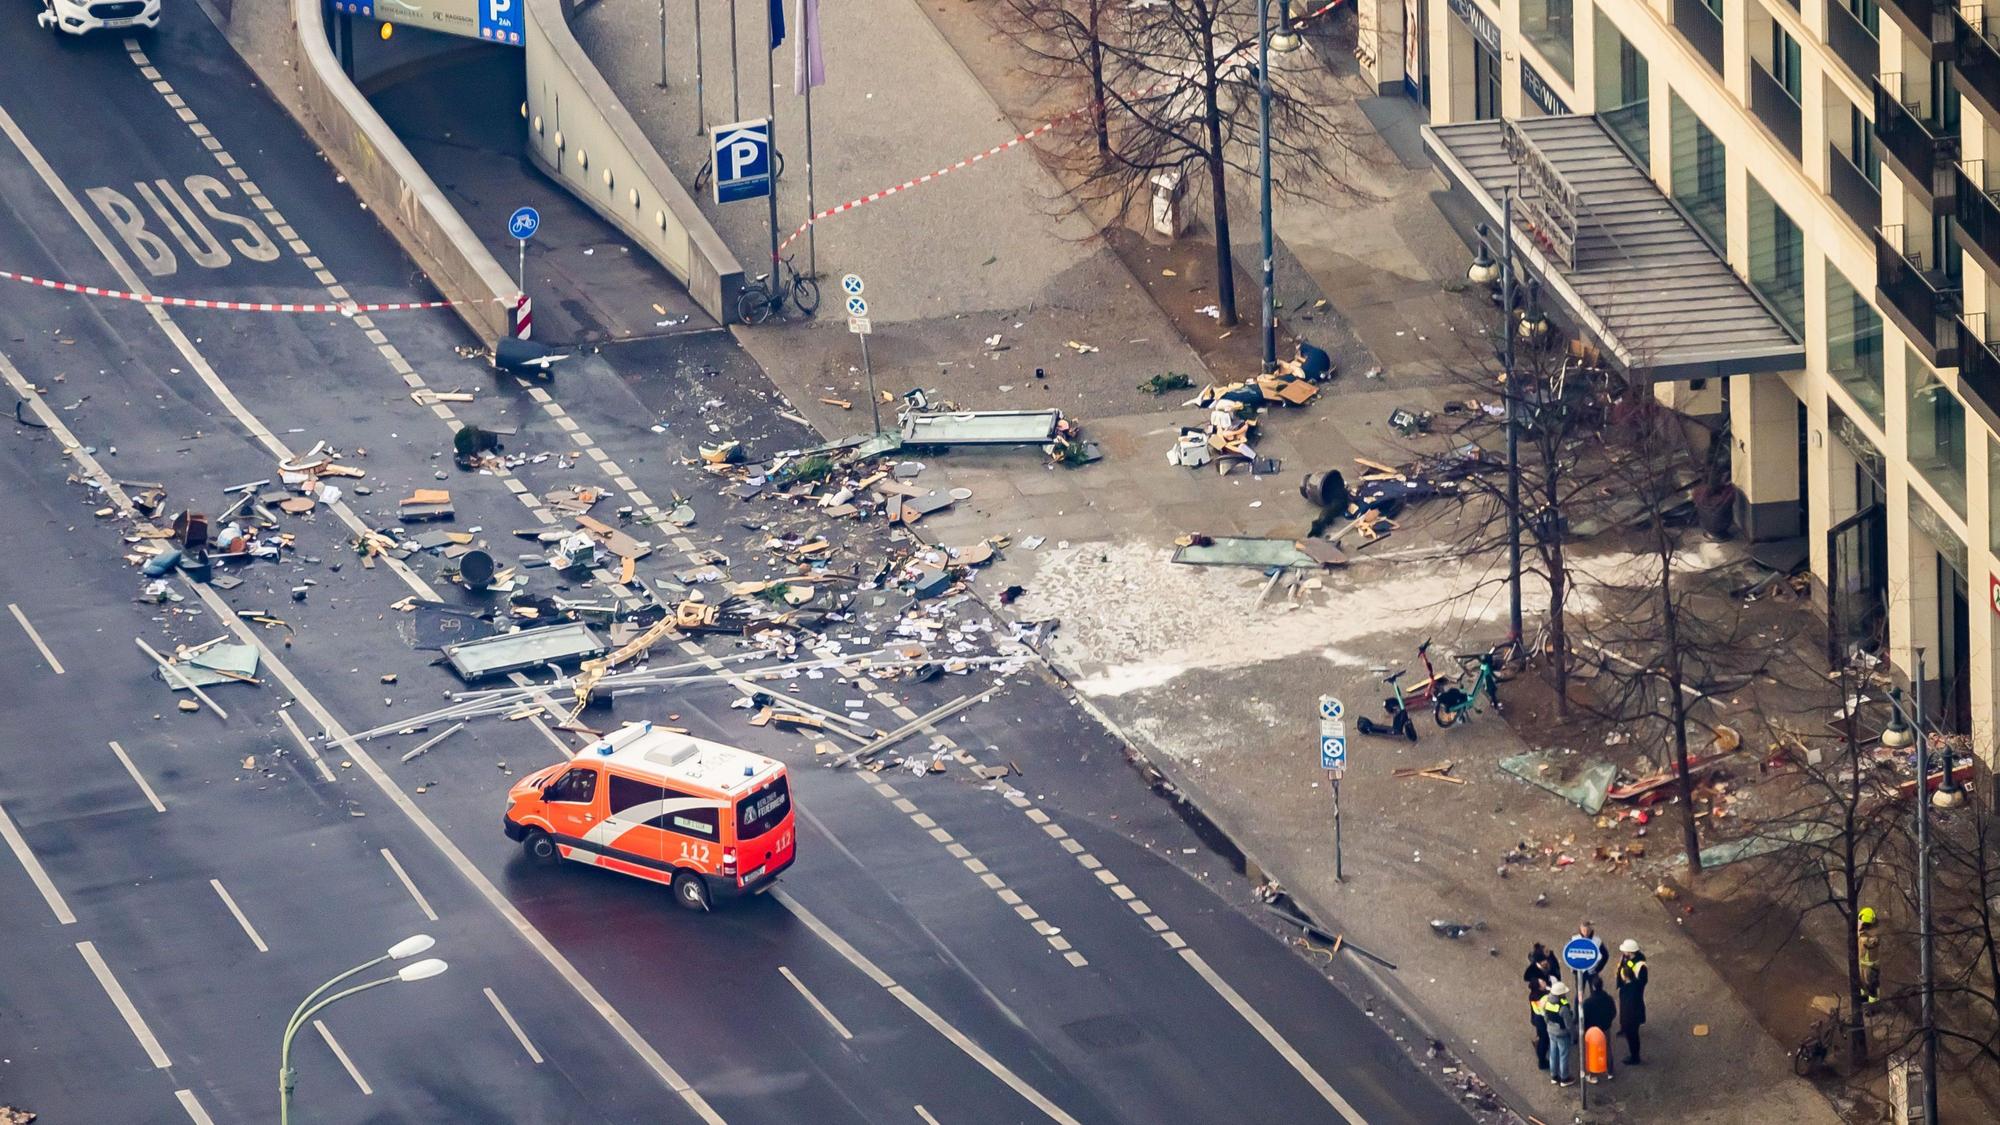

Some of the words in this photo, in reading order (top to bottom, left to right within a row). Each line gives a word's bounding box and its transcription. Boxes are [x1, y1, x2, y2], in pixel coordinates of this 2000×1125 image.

[498, 17, 512, 27] 24h
[731, 141, 759, 180] P
[84, 174, 280, 276] BUS
[680, 841, 709, 863] 112
[775, 831, 791, 854] 112
